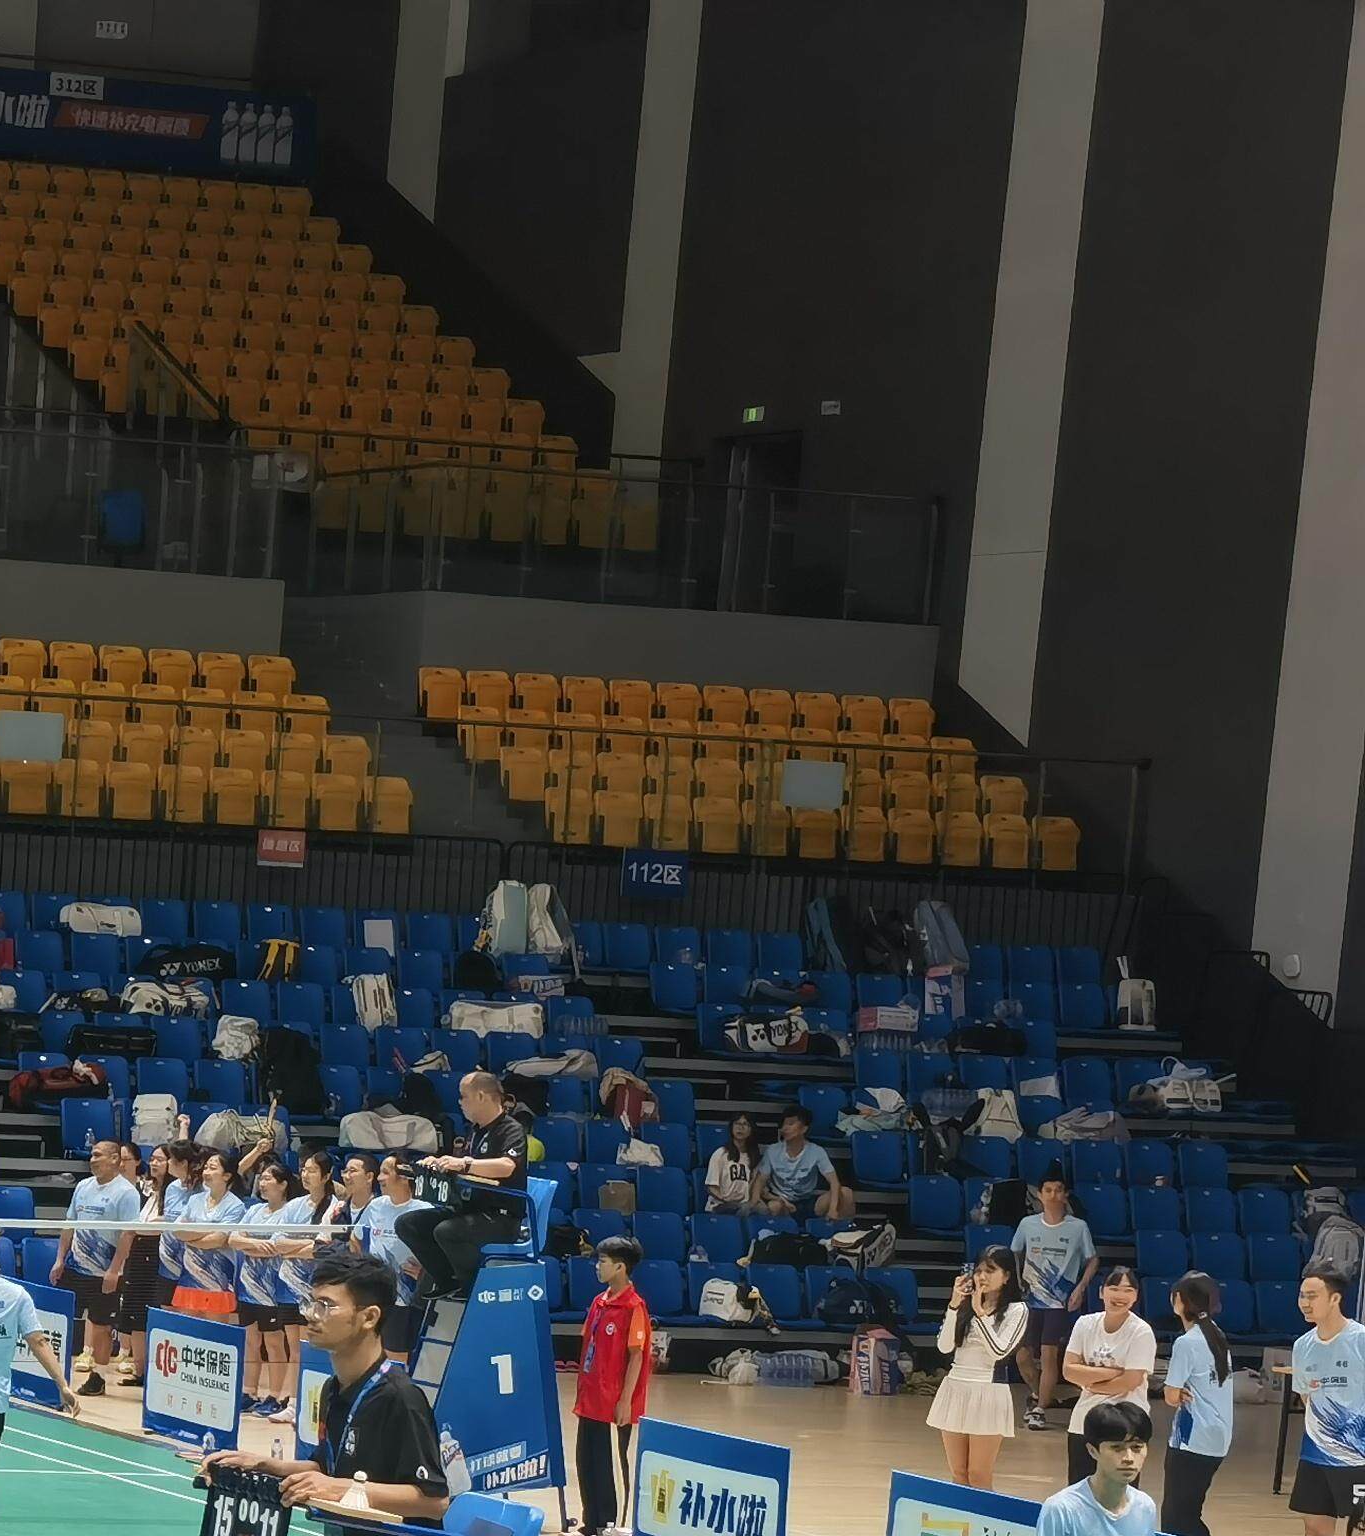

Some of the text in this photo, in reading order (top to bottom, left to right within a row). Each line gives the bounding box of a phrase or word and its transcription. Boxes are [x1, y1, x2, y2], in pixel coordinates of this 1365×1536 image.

[627, 861, 685, 886] 112区
[183, 956, 223, 974] YONEX
[181, 1344, 231, 1377] 中华保险
[180, 1371, 198, 1385] CHINA
[490, 1354, 515, 1395] 1
[238, 1498, 260, 1524] 00
